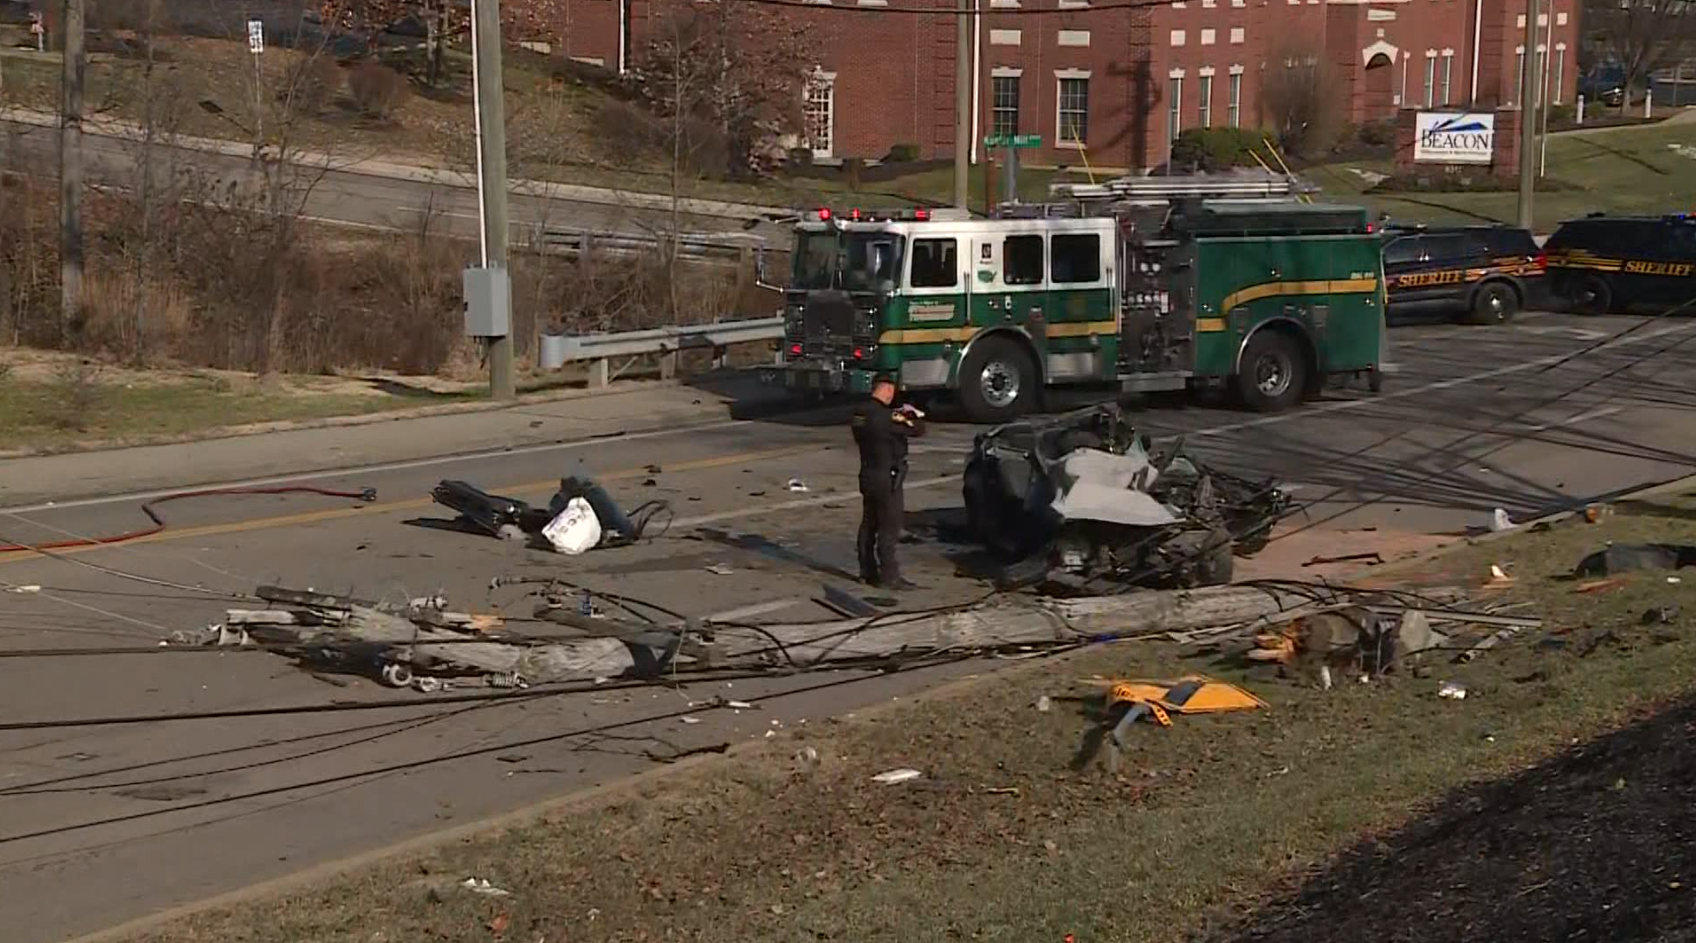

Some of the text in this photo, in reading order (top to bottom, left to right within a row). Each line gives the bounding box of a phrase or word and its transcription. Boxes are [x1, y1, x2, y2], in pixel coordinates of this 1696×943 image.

[1421, 128, 1489, 149] BEACON
[1624, 260, 1694, 277] SHERIFF
[1398, 270, 1464, 287] SHERIFF
